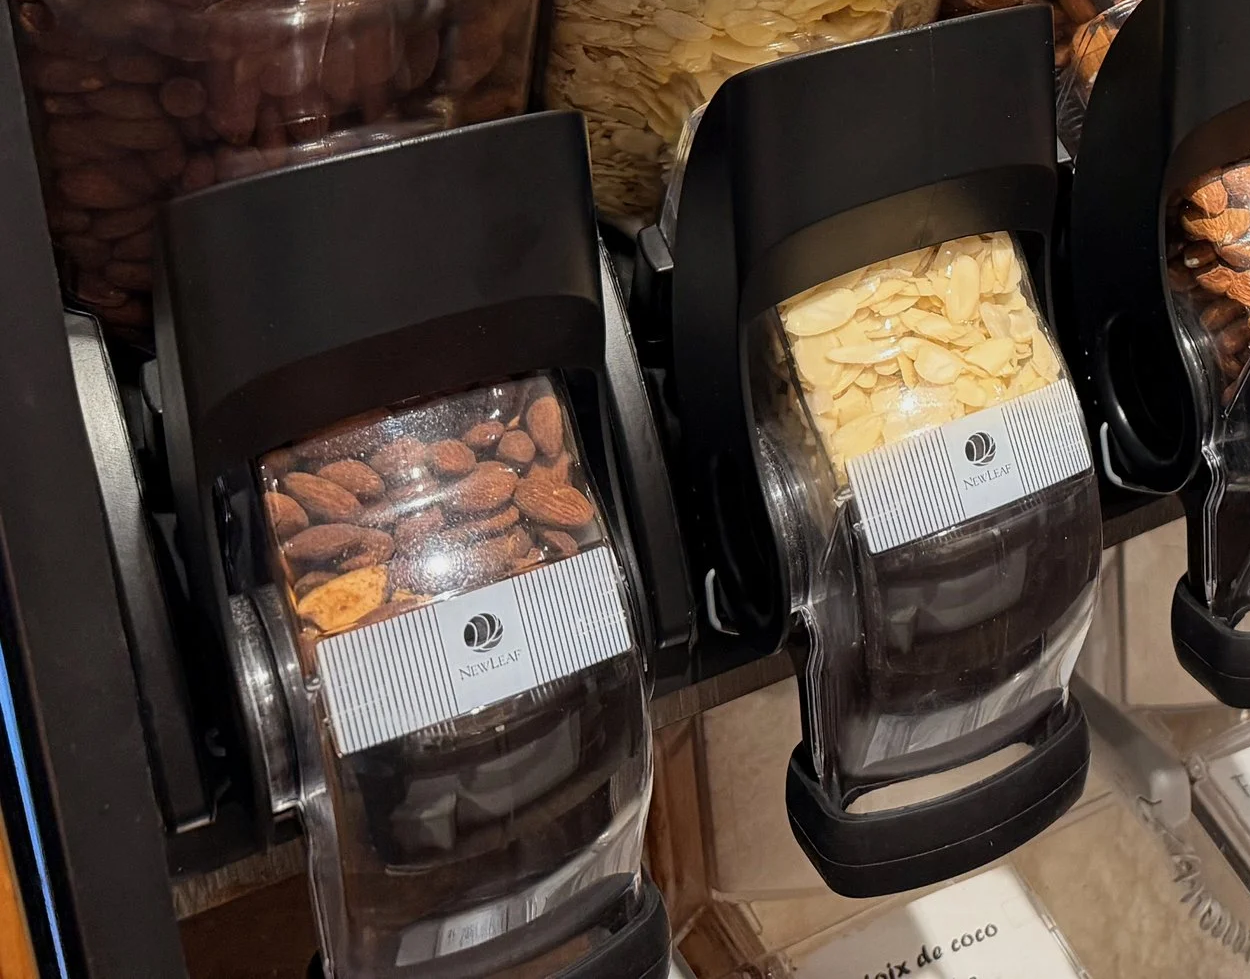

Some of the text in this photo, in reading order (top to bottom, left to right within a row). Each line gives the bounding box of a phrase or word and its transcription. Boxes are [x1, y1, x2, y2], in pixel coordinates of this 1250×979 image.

[963, 463, 1012, 490] NEWLEAF
[458, 649, 522, 680] NEWLEAF
[917, 944, 943, 968] de
[951, 923, 998, 952] coco
